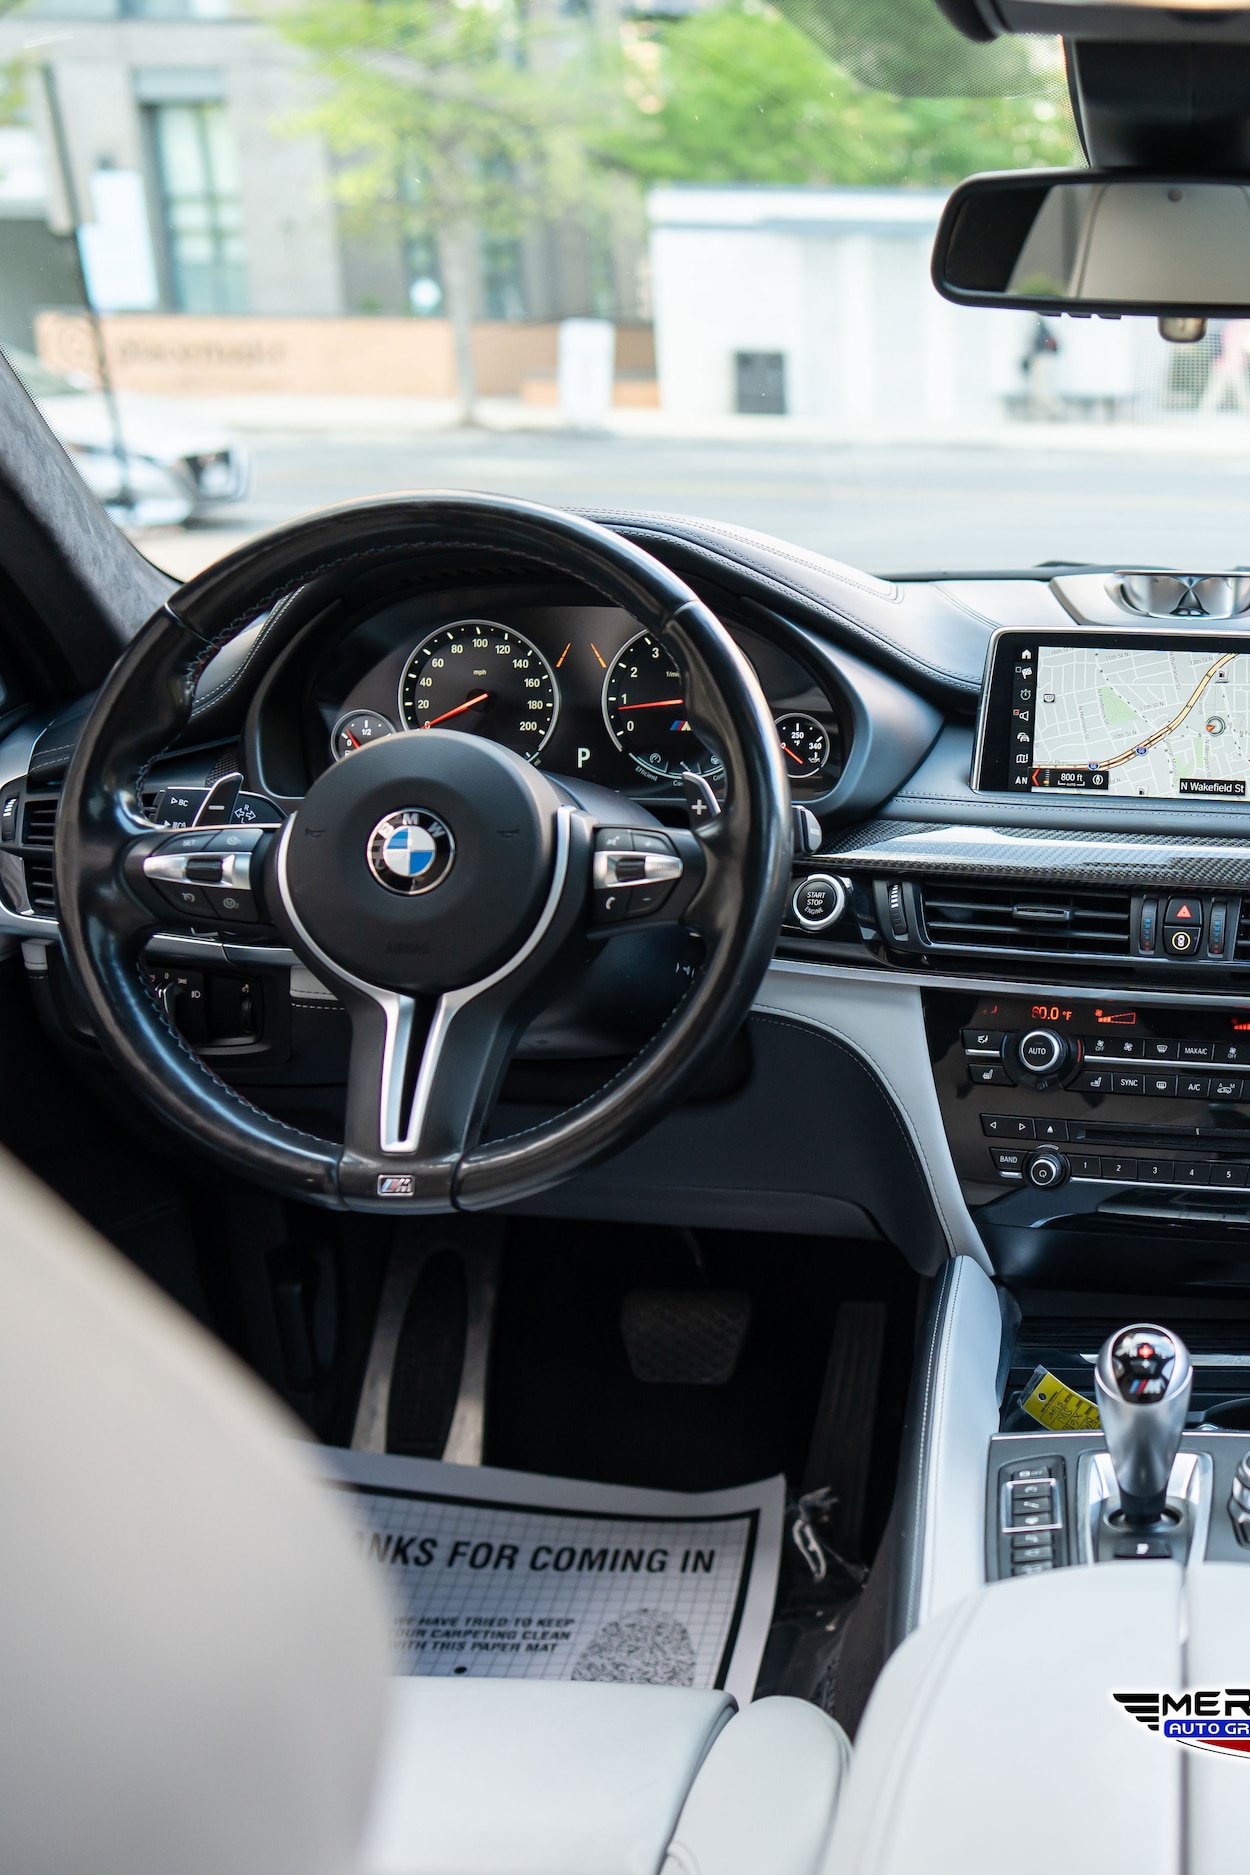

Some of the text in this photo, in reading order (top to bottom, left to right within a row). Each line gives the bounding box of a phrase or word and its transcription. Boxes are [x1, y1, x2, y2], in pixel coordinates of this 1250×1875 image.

[472, 639, 488, 648] 100
[451, 645, 463, 654] 80
[495, 645, 511, 654] 120
[652, 648, 660, 658] 3
[432, 658, 444, 668] 60
[512, 659, 529, 668] 140
[630, 667, 638, 678] 2
[420, 677, 432, 687] 40
[524, 678, 540, 688] 160
[621, 693, 627, 704] 1
[417, 700, 429, 709] 20
[527, 701, 543, 709] 180
[520, 722, 537, 731] 200
[626, 721, 635, 731] 0
[361, 728, 372, 736] 1/2
[791, 731, 805, 739] 250
[808, 742, 822, 750] 340
[577, 748, 591, 768] P
[1060, 773, 1083, 782] 800 ft
[1180, 781, 1188, 791] N
[1189, 782, 1233, 793] Wakefield
[1234, 784, 1245, 793] St
[178, 798, 189, 807] BC
[378, 813, 446, 839] BMW
[806, 891, 826, 899] START
[804, 906, 825, 915] ENGINE
[1031, 1005, 1060, 1020] 60.0
[1027, 1047, 1047, 1055] AUTO
[1120, 1078, 1139, 1087] SYNC
[1188, 1083, 1201, 1091] A/C
[999, 1155, 1018, 1164] BAND
[1116, 1164, 1122, 1172] 2
[1152, 1166, 1158, 1175] 3
[1189, 1168, 1194, 1176] 4
[1226, 1170, 1232, 1178] 5
[447, 1540, 520, 1570] FOR
[529, 1545, 669, 1573] COMING
[680, 1549, 715, 1574] IN
[418, 1616, 459, 1627] HAVE
[465, 1616, 509, 1628] TRIED
[514, 1617, 533, 1628] TO
[536, 1617, 575, 1628] KEEP
[430, 1629, 517, 1640] CARPETING
[521, 1631, 572, 1640] CLEAN
[431, 1641, 466, 1651] THIS
[470, 1641, 520, 1652] PAPER
[524, 1642, 558, 1652] MAT
